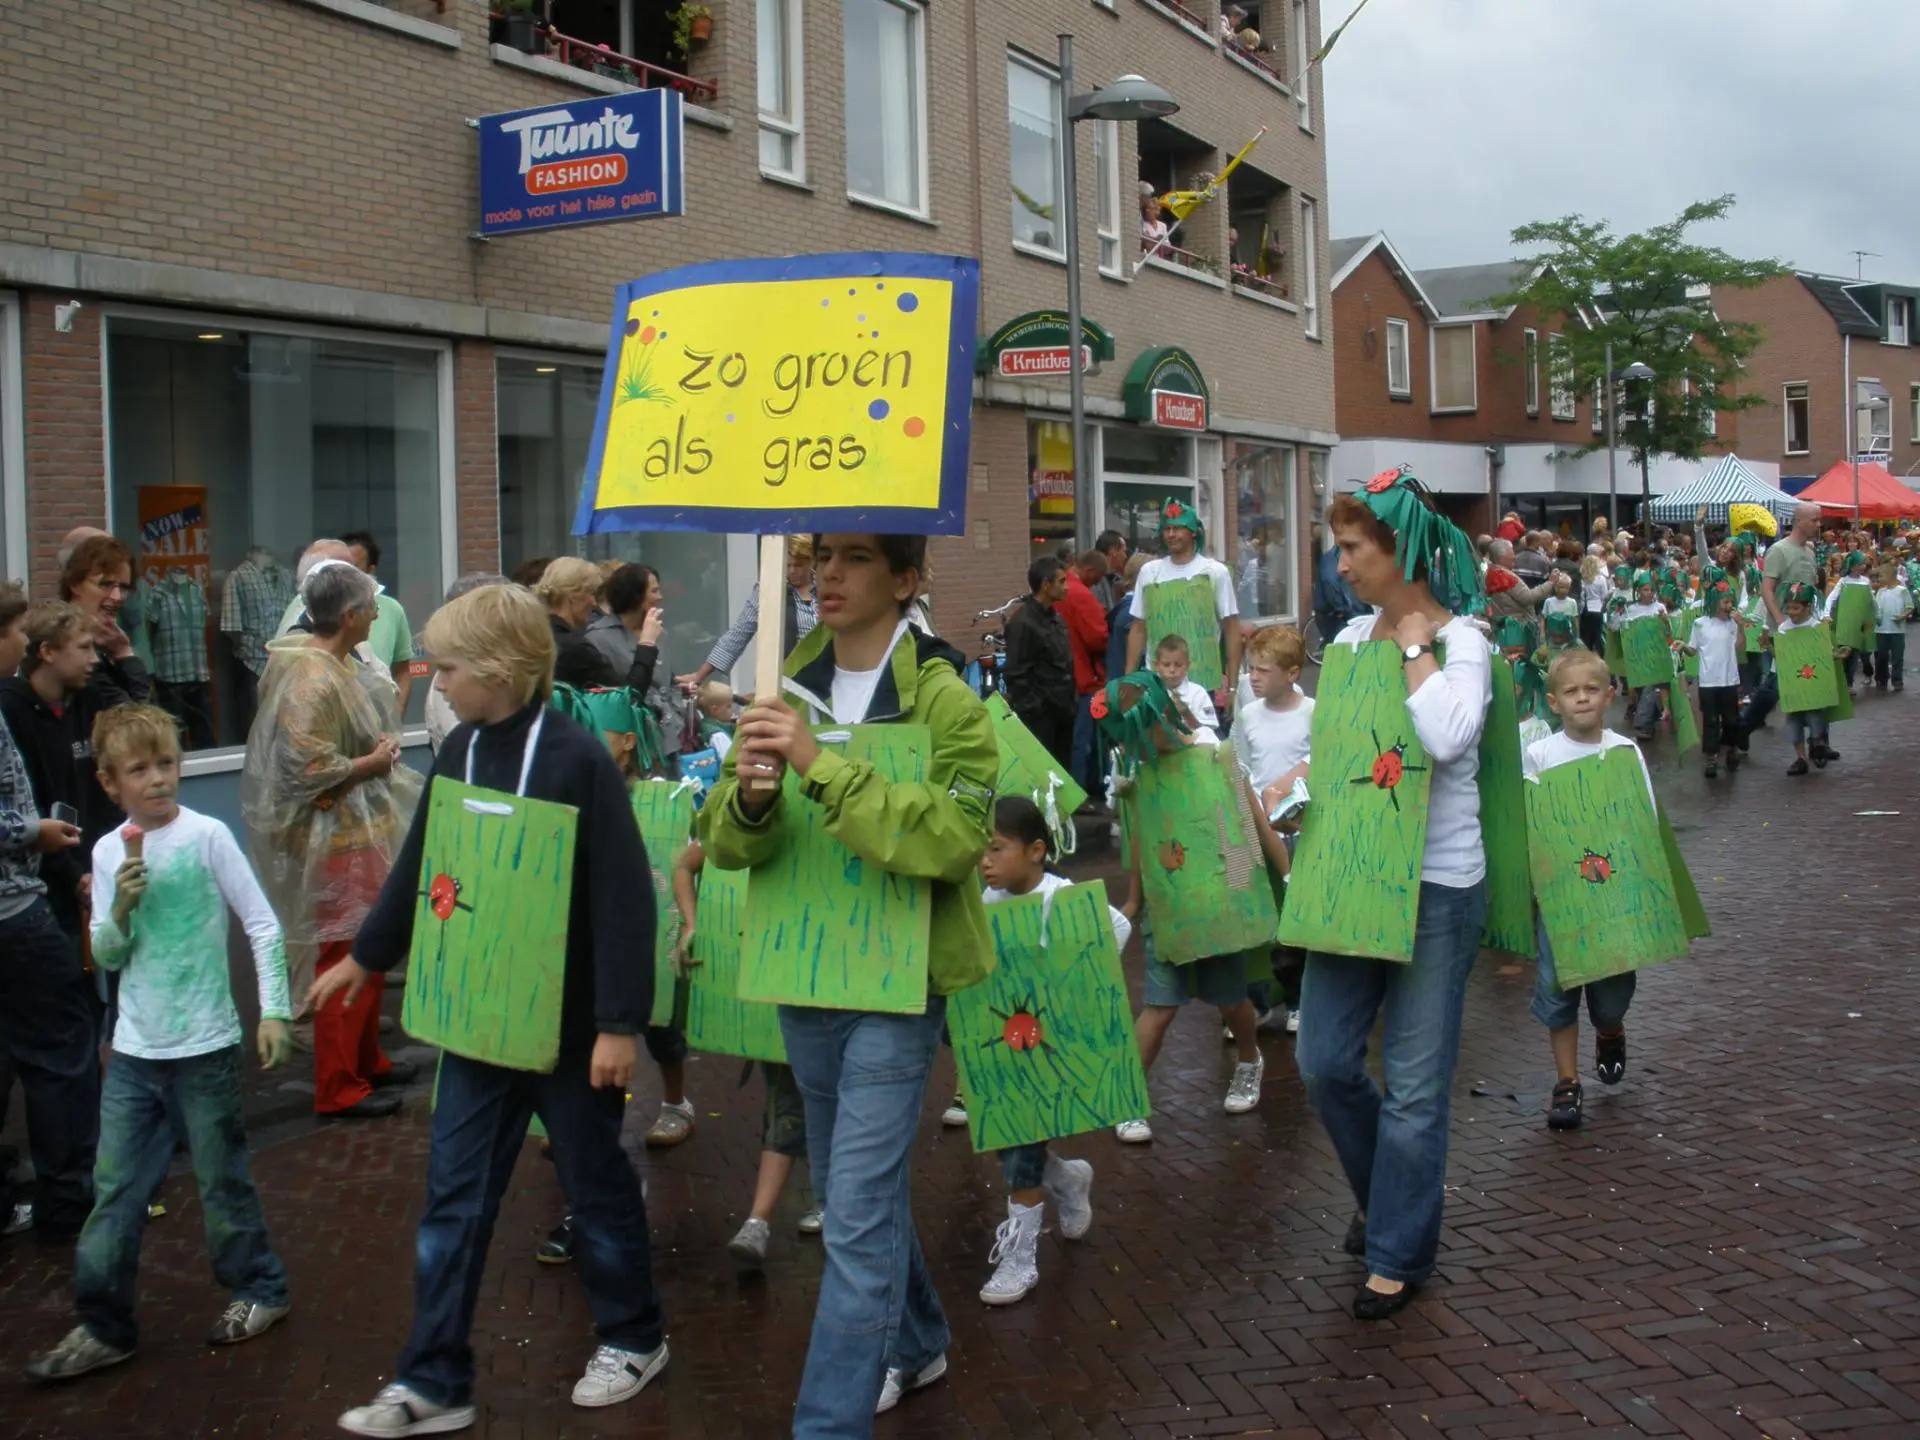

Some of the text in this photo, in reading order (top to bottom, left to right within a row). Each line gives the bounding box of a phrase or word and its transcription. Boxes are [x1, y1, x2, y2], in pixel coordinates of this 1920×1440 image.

[500, 107, 640, 175] Tuunte
[535, 161, 618, 188] FASHION
[485, 208, 522, 224] mode
[526, 205, 557, 220] voor
[560, 199, 582, 215] het
[620, 190, 657, 209] gezin
[678, 346, 912, 418] zo groen
[1013, 352, 1071, 371] Kruidva
[643, 411, 867, 487] als gras
